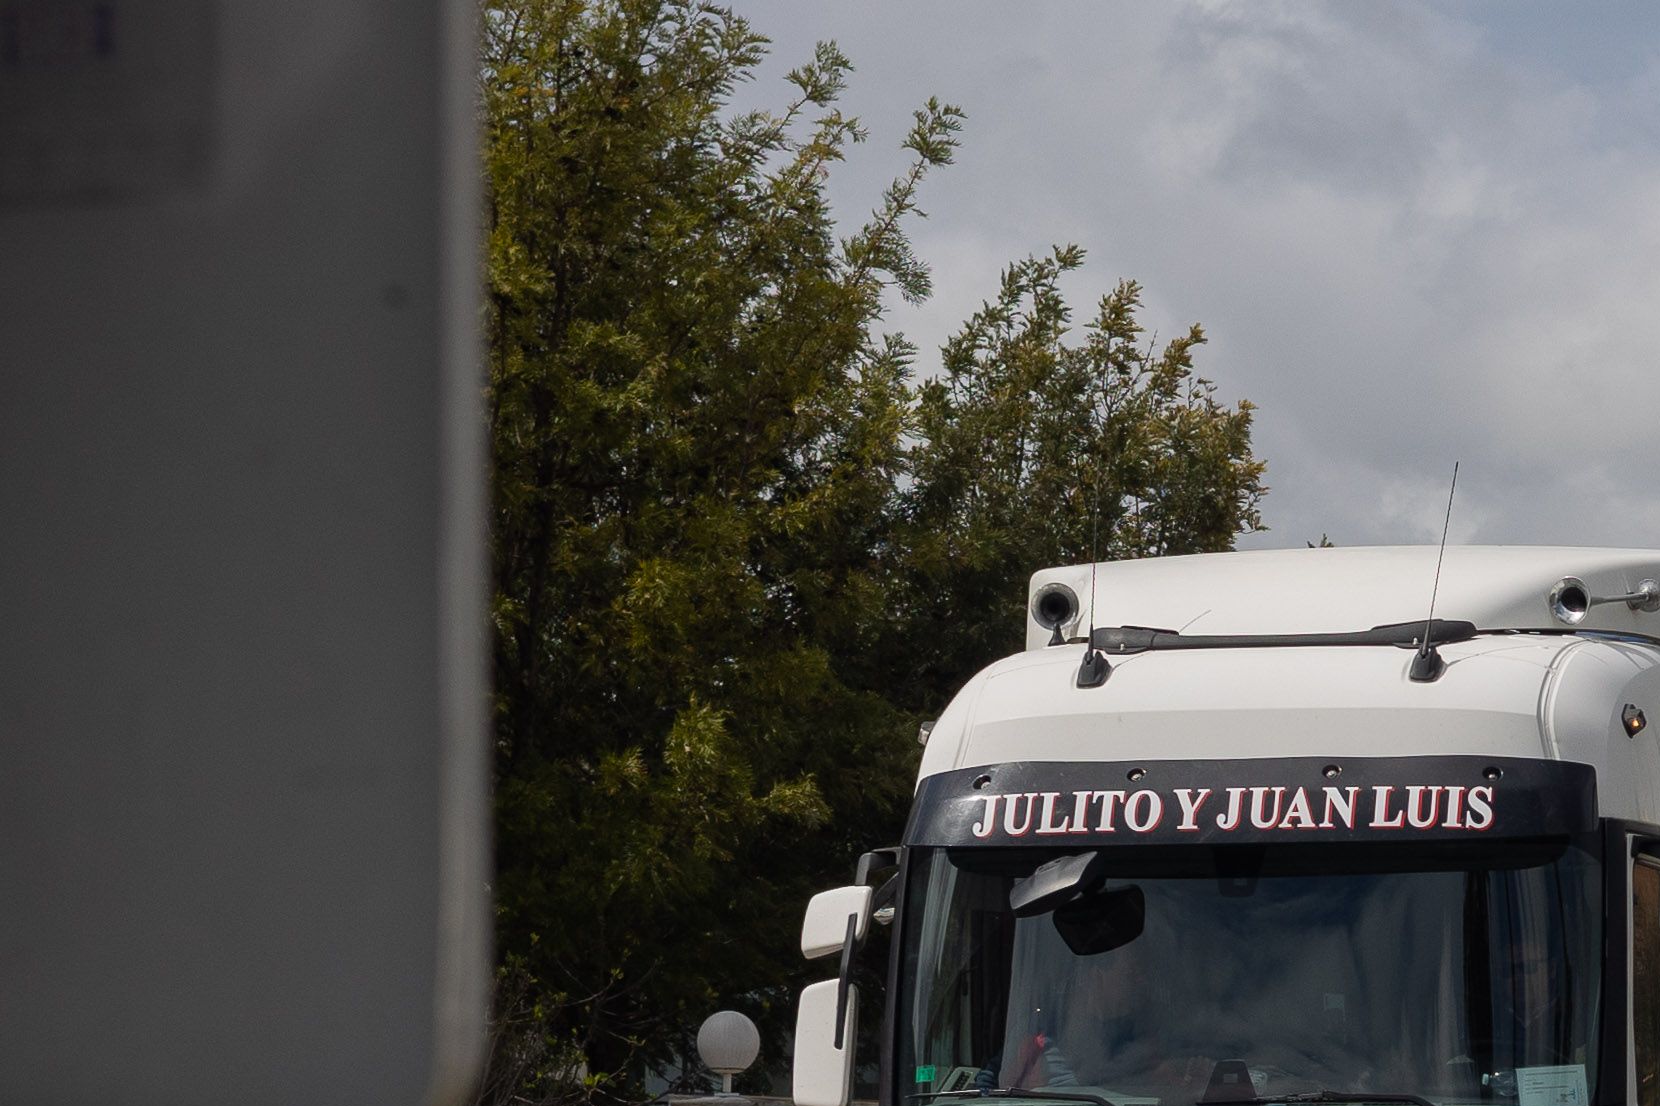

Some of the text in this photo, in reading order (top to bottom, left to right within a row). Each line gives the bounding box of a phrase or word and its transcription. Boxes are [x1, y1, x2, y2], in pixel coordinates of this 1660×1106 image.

[972, 785, 1495, 839] JULITO Y JUAN LUIS
